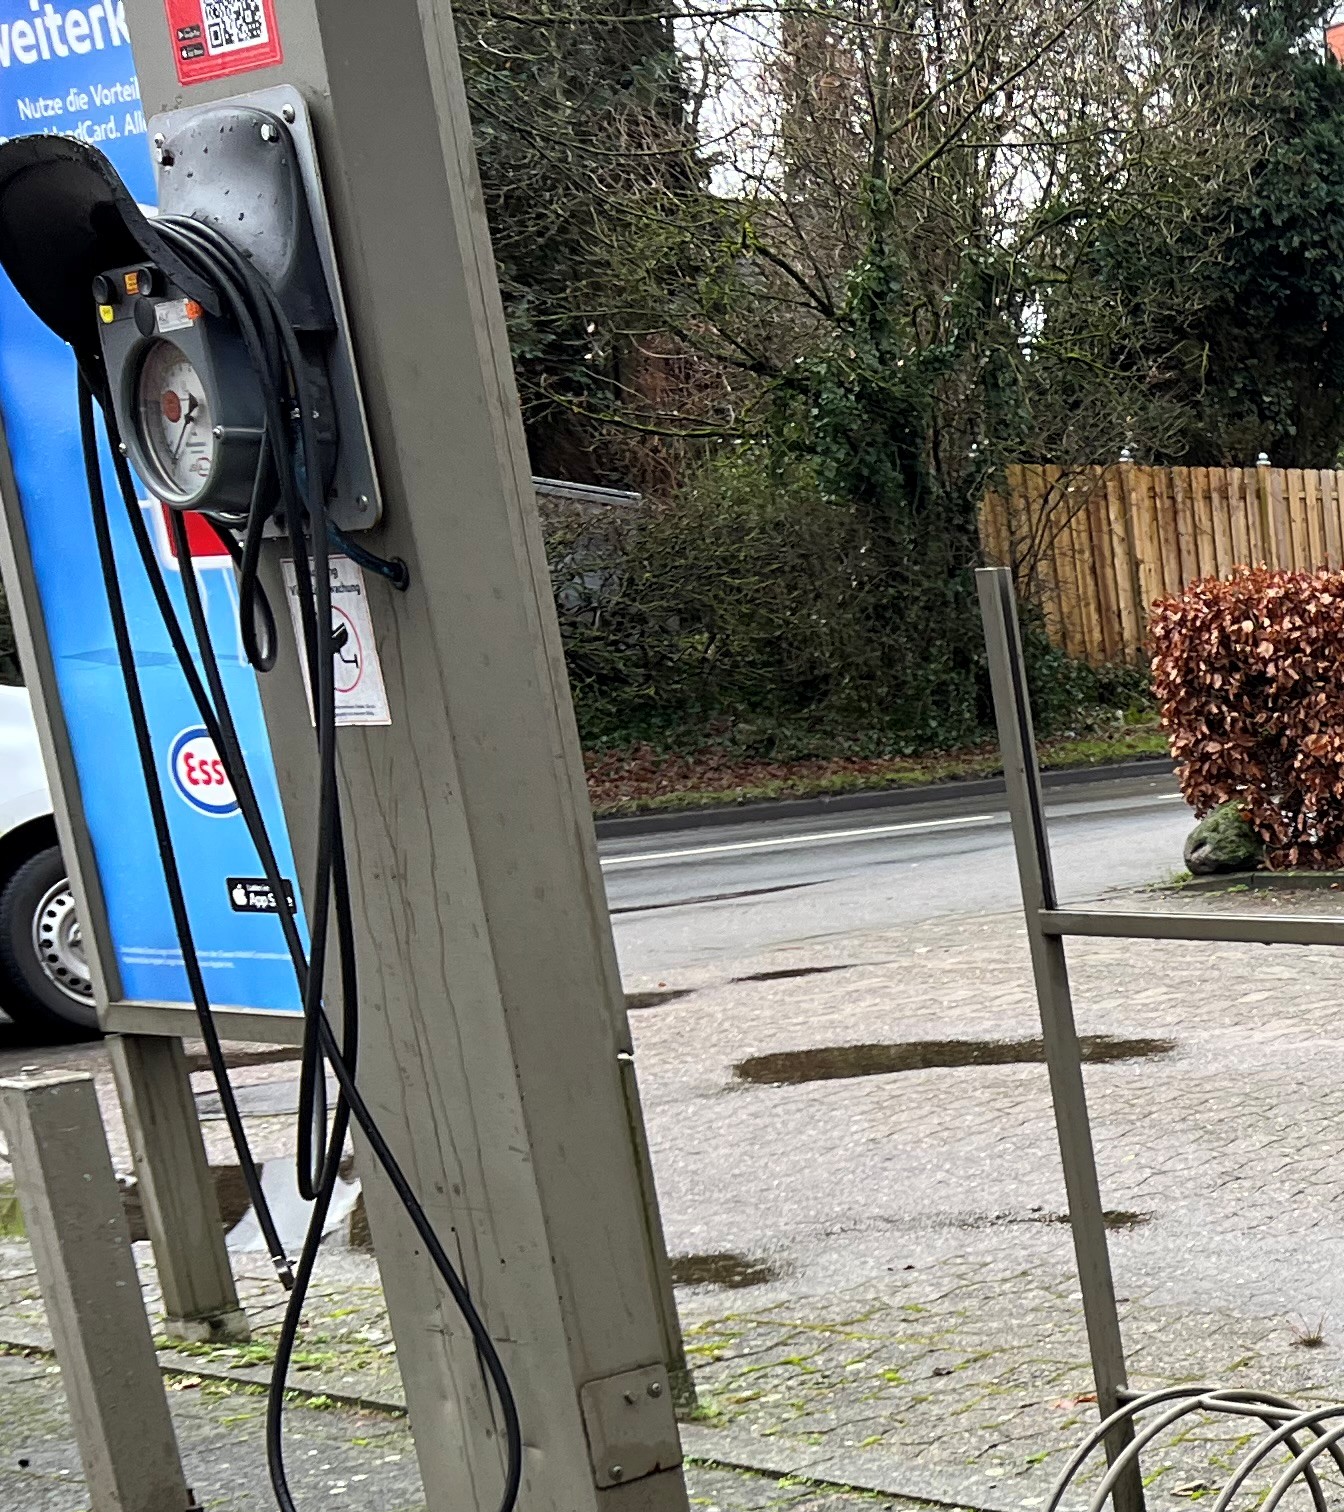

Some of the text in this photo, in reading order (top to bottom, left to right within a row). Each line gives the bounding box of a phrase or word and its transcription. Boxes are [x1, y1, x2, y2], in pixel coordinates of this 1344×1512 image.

[17, 97, 63, 121] Nutze
[66, 87, 89, 113] die
[183, 751, 225, 786] Ess
